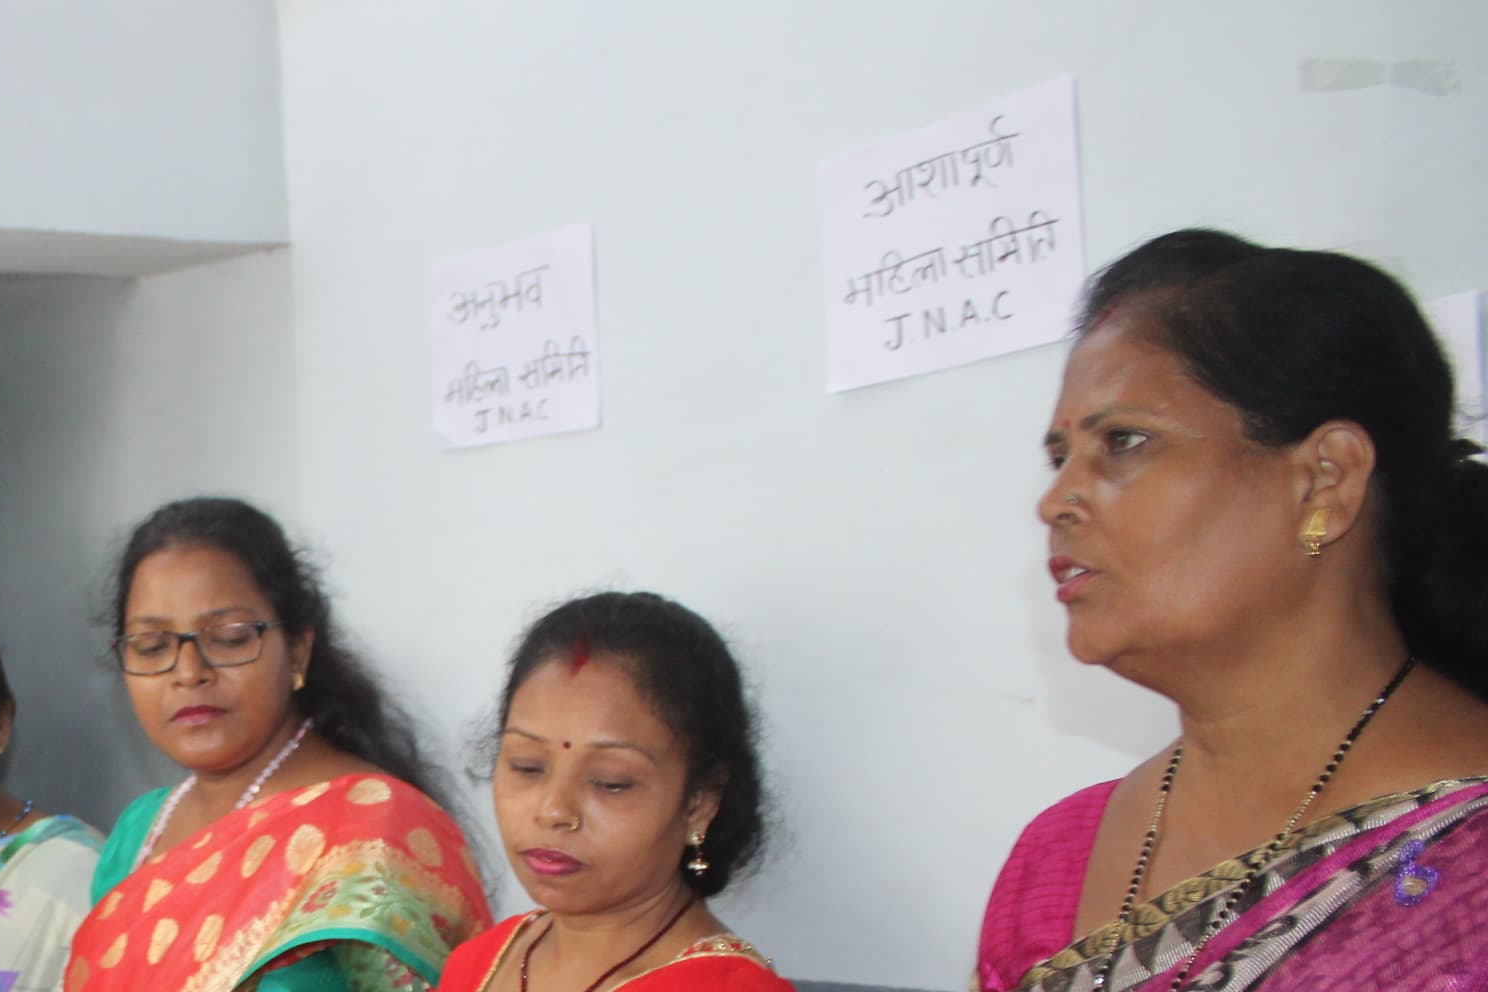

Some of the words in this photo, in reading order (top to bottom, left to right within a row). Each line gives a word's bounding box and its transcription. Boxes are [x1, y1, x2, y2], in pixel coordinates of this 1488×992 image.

[843, 248, 945, 307] महिला
[952, 209, 1060, 280] समिति
[446, 263, 551, 331] अनुभव
[444, 359, 510, 406] महिला
[518, 334, 591, 391] समिति
